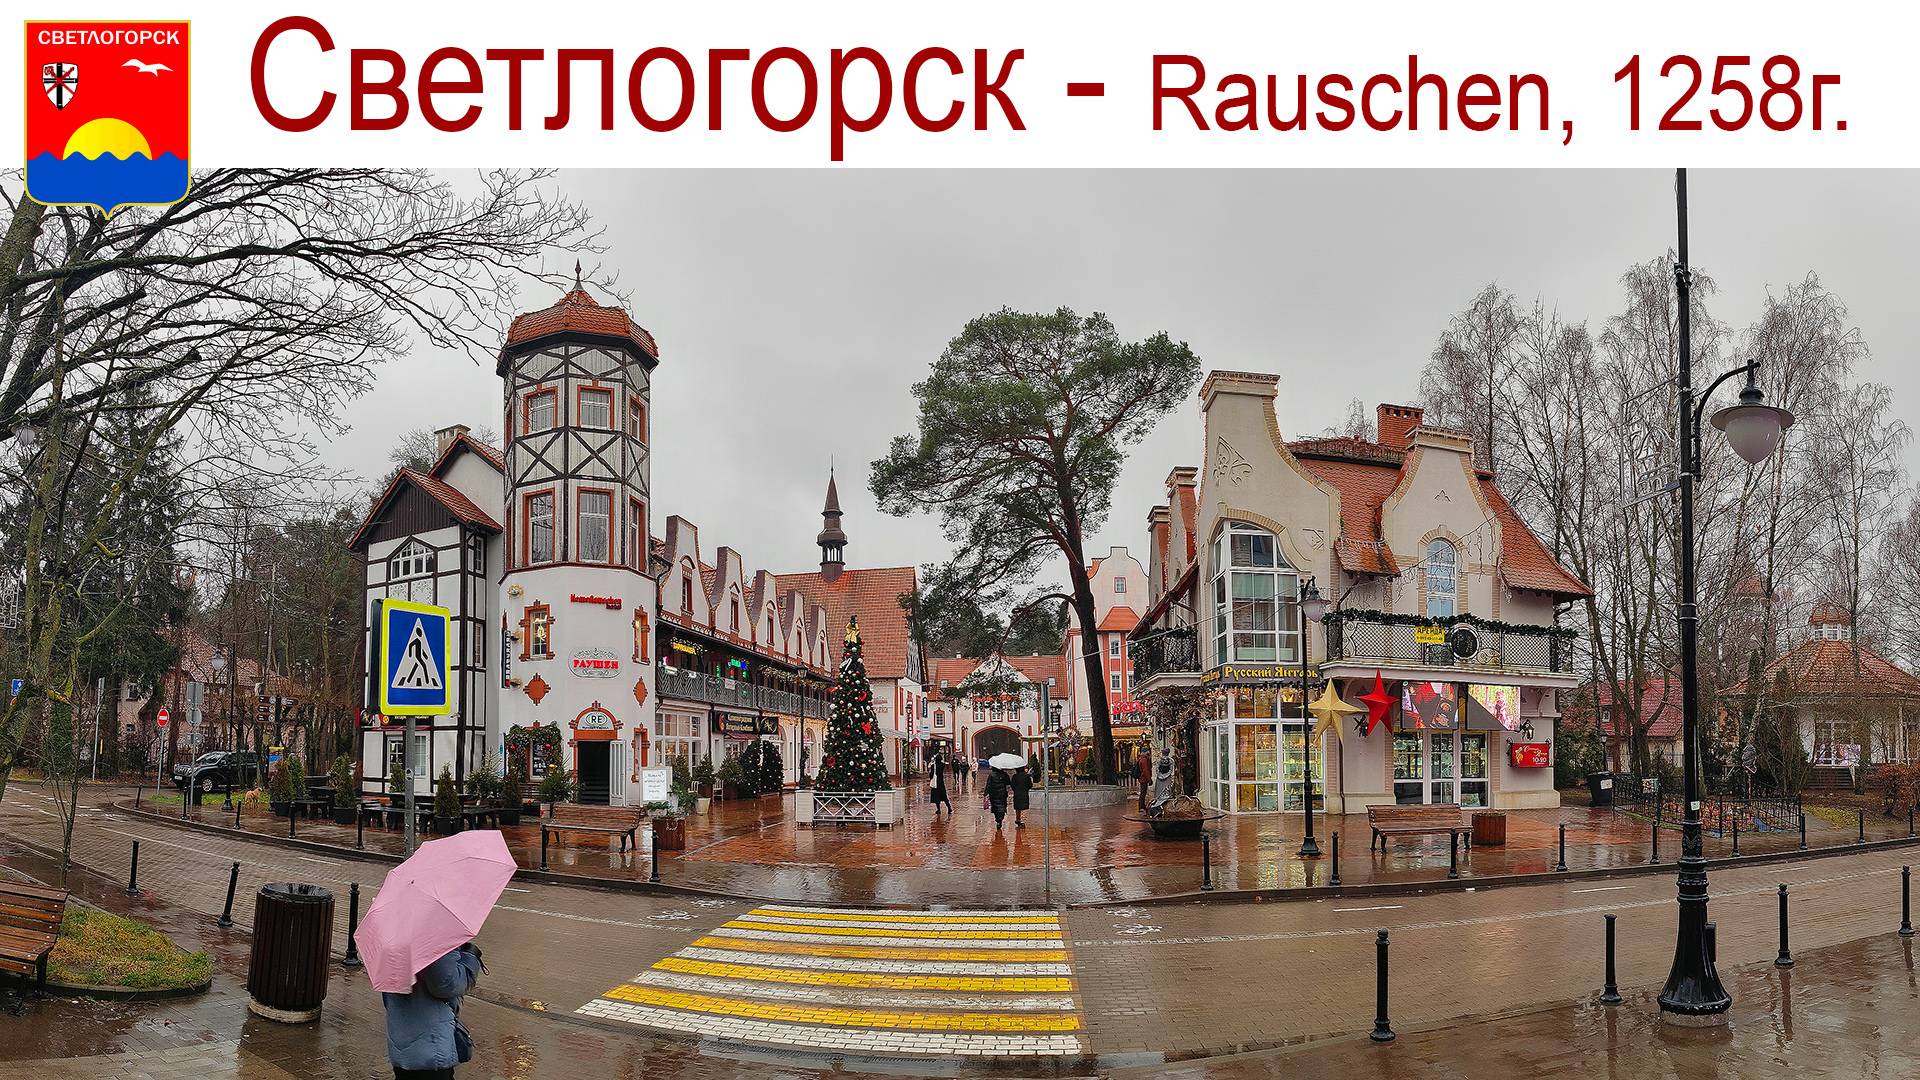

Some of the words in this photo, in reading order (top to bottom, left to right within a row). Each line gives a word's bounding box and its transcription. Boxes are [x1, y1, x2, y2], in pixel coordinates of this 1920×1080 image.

[573, 659, 619, 670] РАУШЕН
[1224, 666, 1272, 680] Русский
[591, 715, 603, 724] RE
